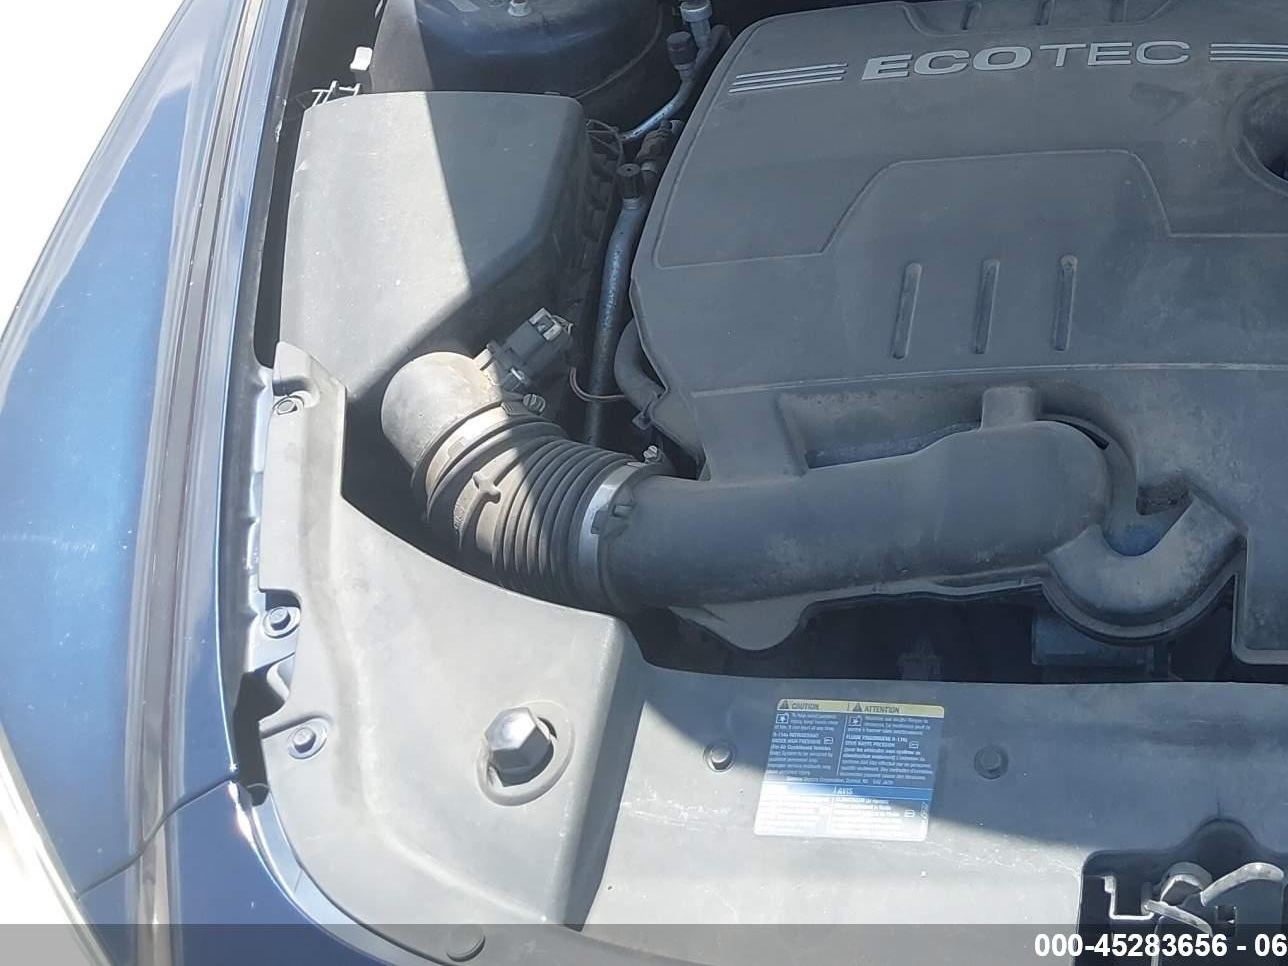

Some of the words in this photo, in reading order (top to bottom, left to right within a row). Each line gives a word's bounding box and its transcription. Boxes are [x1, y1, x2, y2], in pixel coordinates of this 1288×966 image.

[861, 40, 1191, 81] ECOTEC
[791, 702, 820, 710] CAUTION
[864, 705, 900, 714] ATTENTION
[837, 787, 854, 795] AVIS
